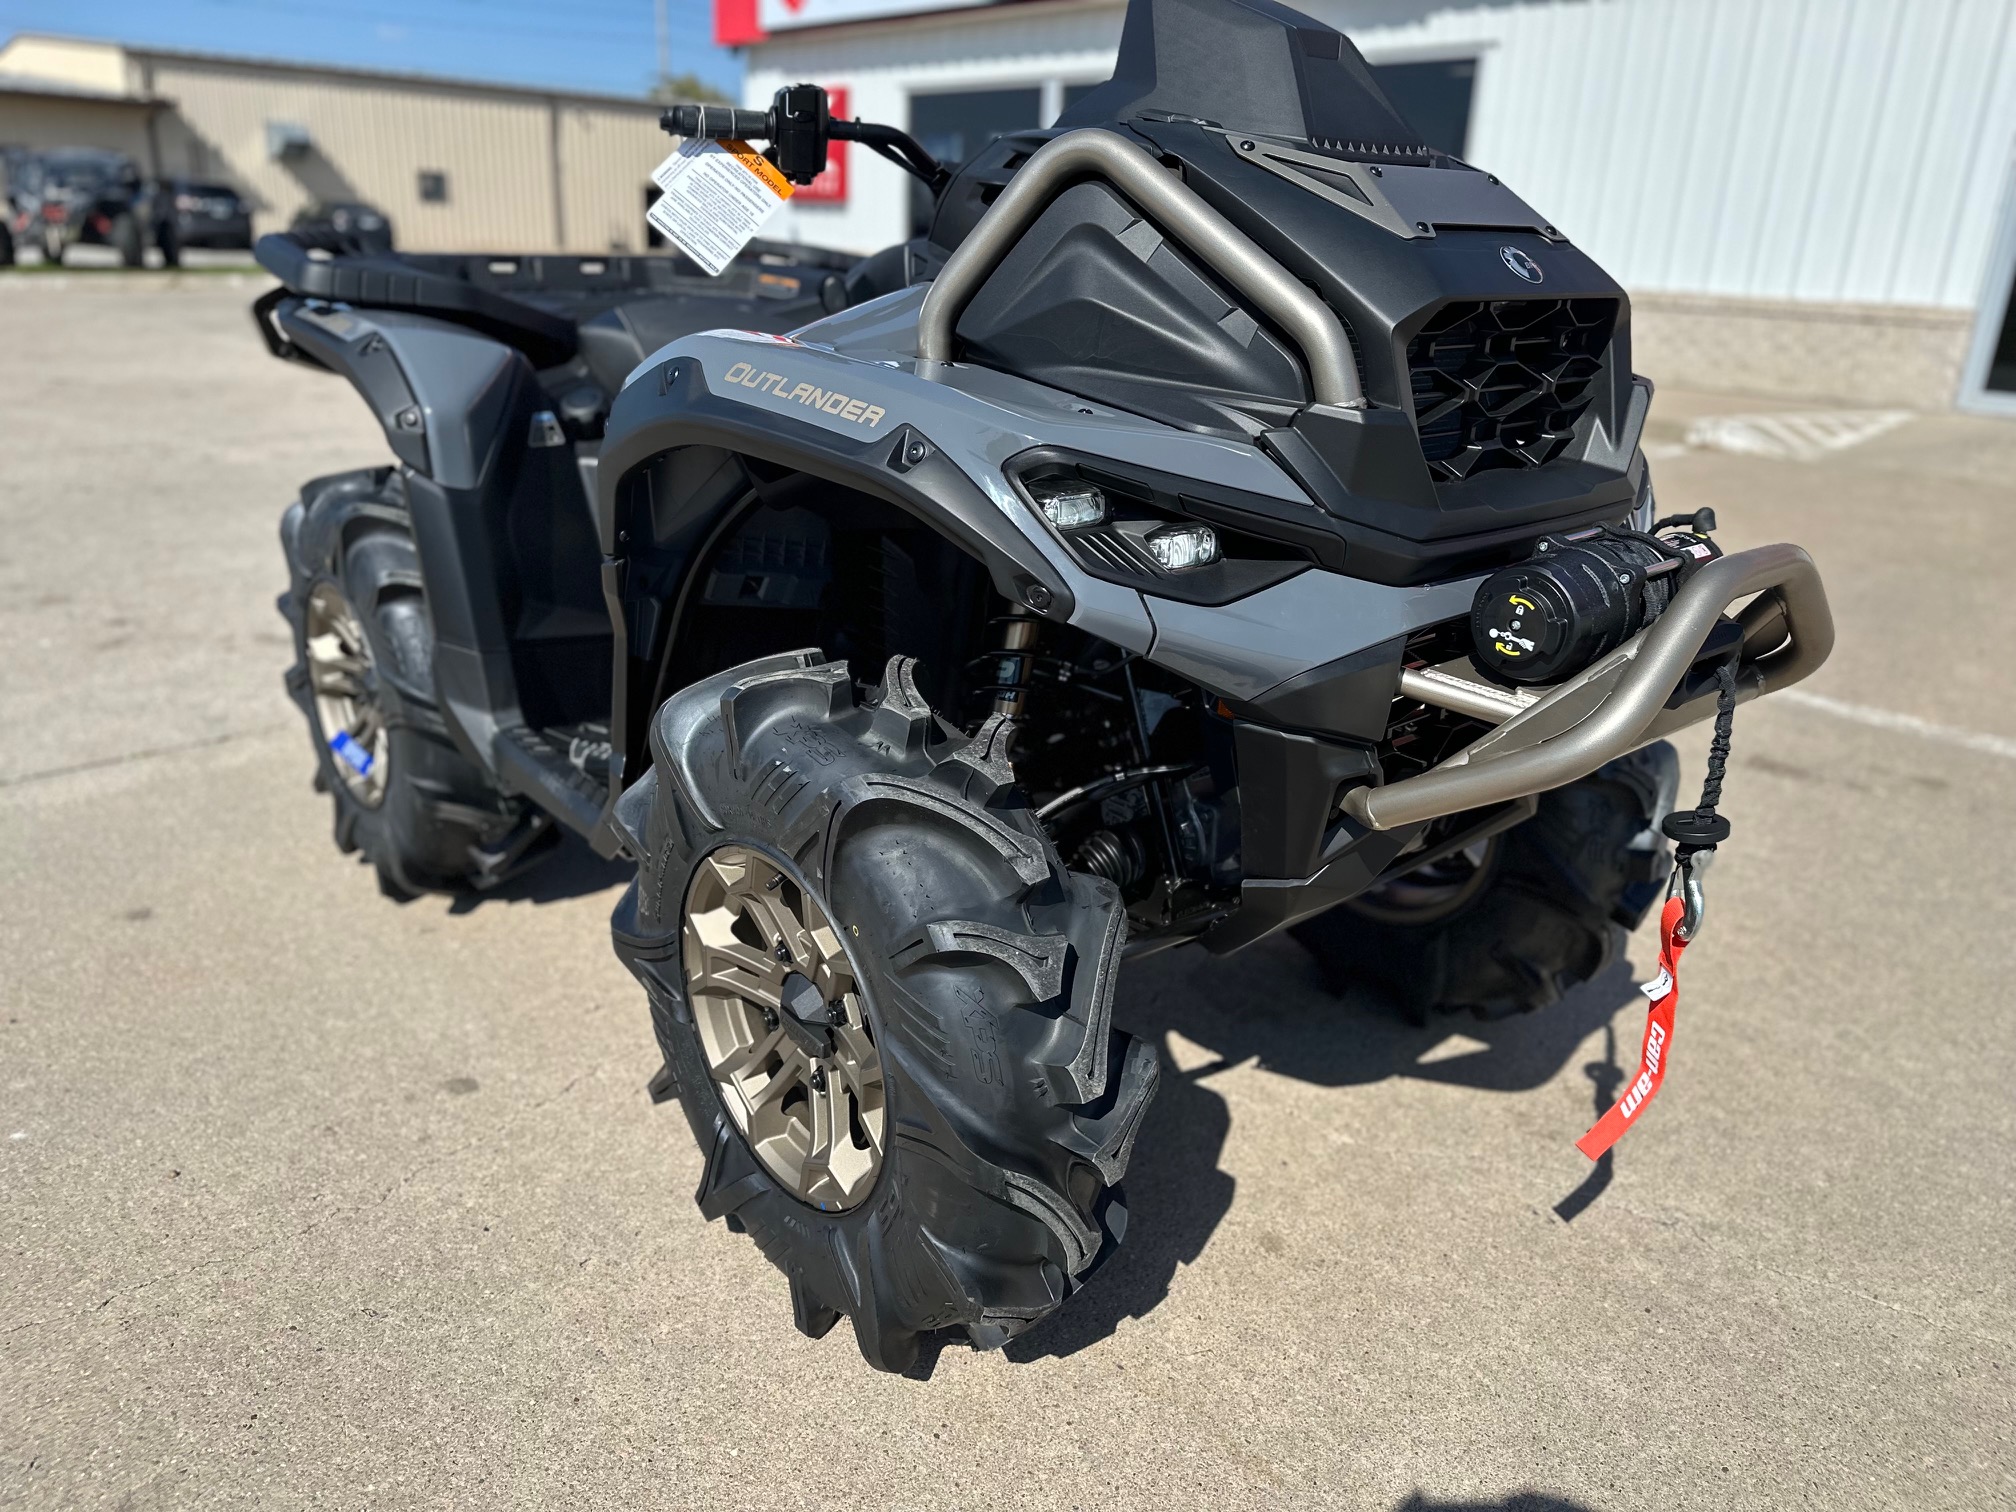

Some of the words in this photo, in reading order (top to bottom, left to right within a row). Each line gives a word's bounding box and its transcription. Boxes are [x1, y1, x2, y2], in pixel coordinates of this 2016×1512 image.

[725, 142, 754, 168] SPORT
[753, 167, 784, 195] MODEL
[753, 155, 764, 167] S
[724, 362, 886, 428] OUTLANDER
[1619, 1020, 1666, 1119] can-am
